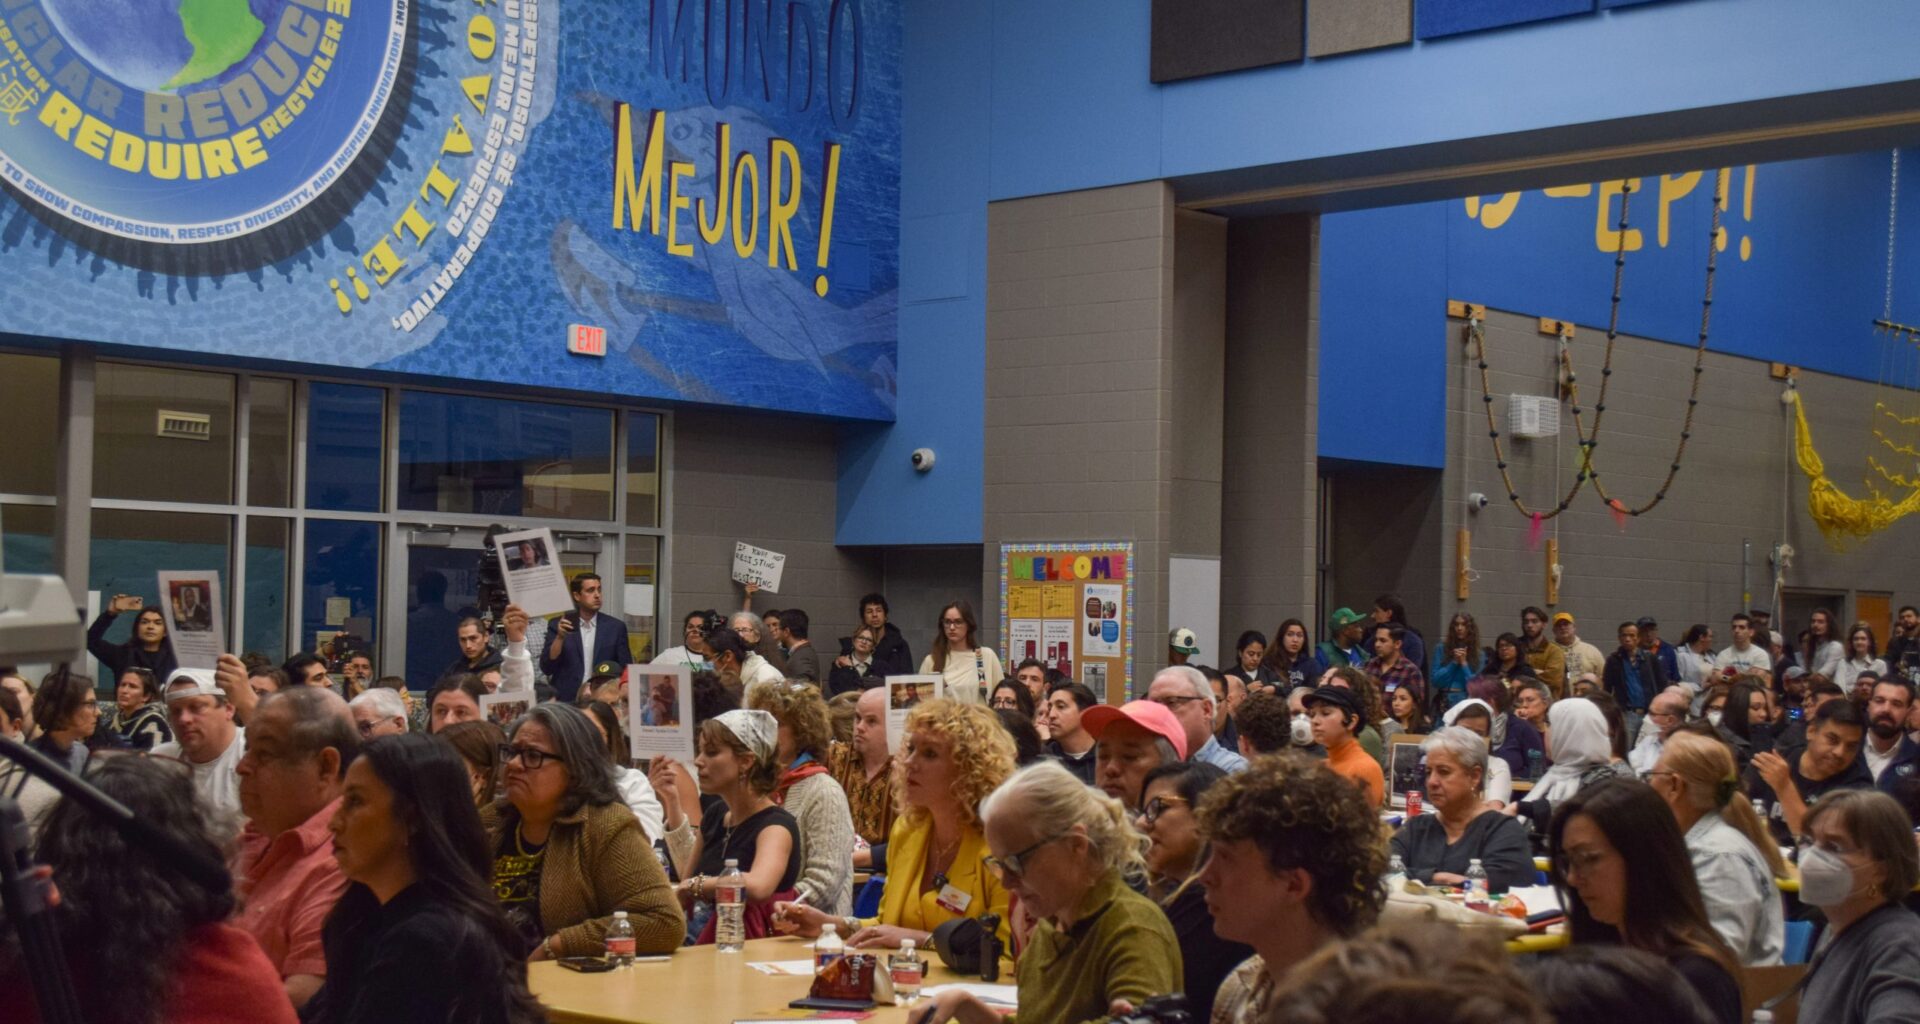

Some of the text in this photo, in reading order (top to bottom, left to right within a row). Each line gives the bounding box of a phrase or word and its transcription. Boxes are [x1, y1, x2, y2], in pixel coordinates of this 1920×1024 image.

[4, 32, 402, 242] TO SHOW COMPASSION, RESPECT DIVERSITY, AND INSPIRE INNOVATION!
[38, 18, 343, 180] REDUIRE RECYCLER
[495, 23, 520, 112] MEJOR
[648, 0, 862, 132] MUNDO
[329, 0, 498, 313] OVALLE!!
[392, 0, 539, 333] SPETUOSO, SÉ COOPERATIVO,
[446, 113, 507, 238] ESFUERZO
[612, 101, 841, 298] MEJOR!
[575, 325, 604, 354] EXIT
[1011, 554, 1125, 581] WELCOME
